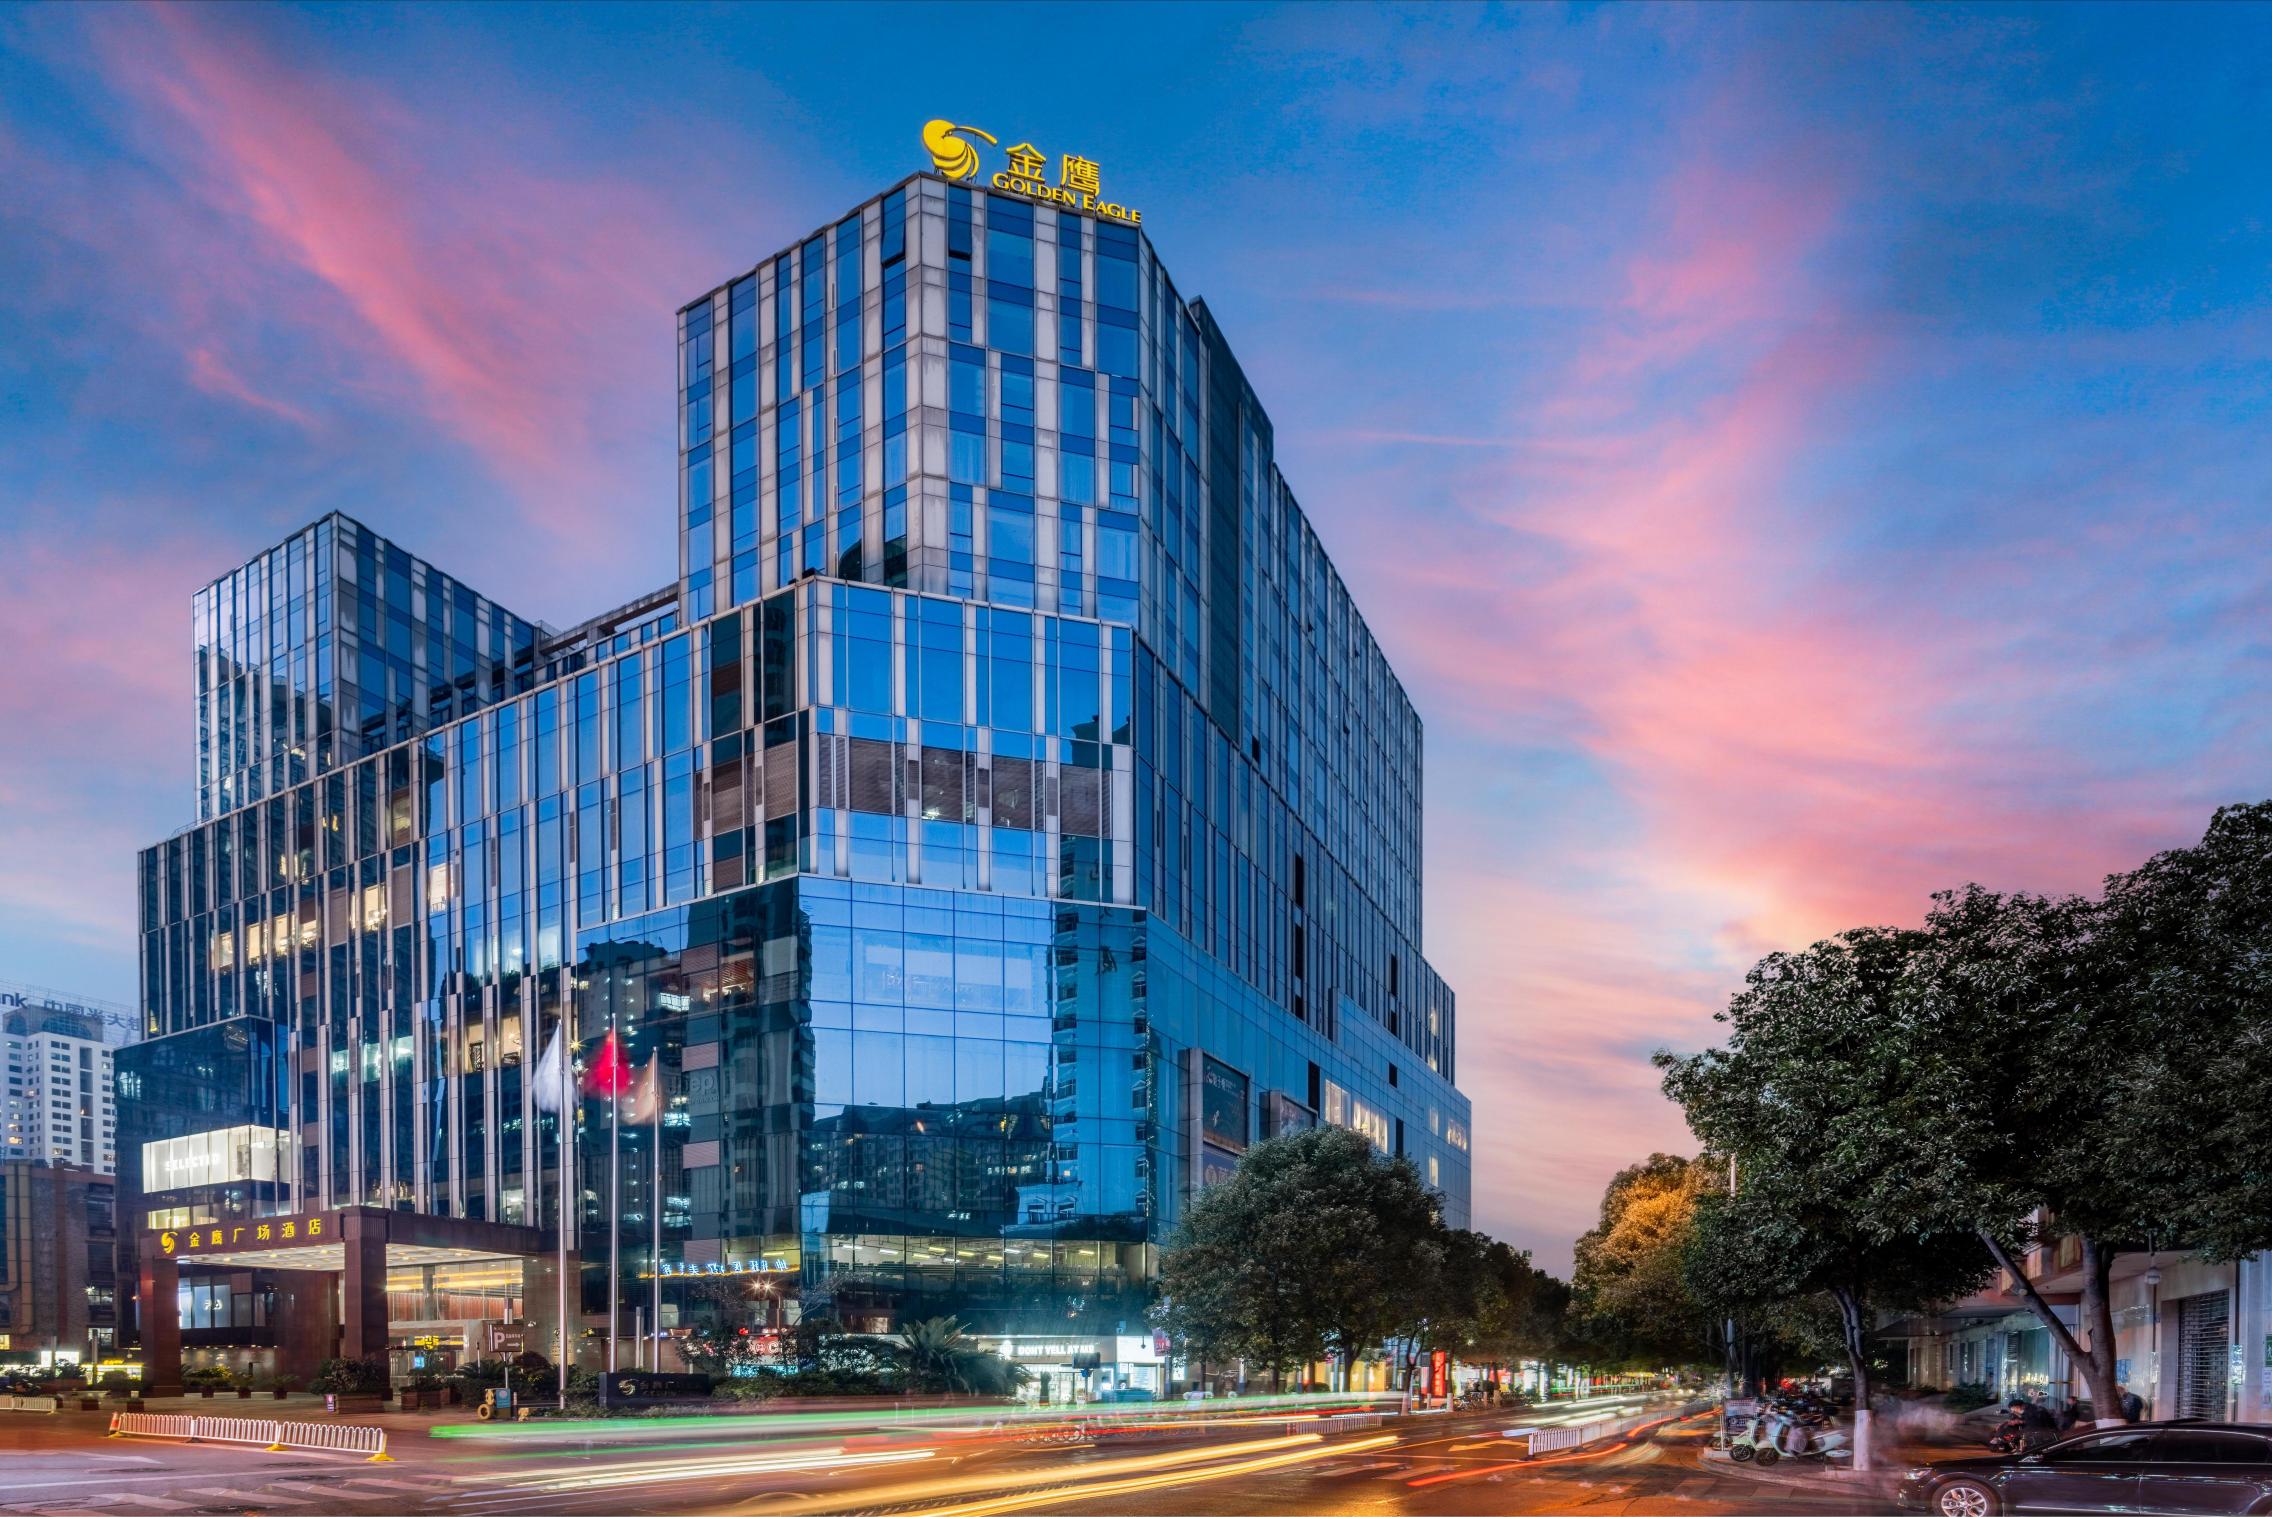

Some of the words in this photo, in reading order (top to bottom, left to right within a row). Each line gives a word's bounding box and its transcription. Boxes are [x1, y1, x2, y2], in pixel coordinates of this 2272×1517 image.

[1006, 142, 1100, 198] 金鹰
[992, 172, 1076, 206] GOLDEN
[1083, 193, 1142, 223] EAGLE
[0, 992, 28, 1009] nk
[189, 1218, 321, 1249] 金鹰广场酒店
[494, 1332, 505, 1350] P
[1045, 1344, 1067, 1355] YELL
